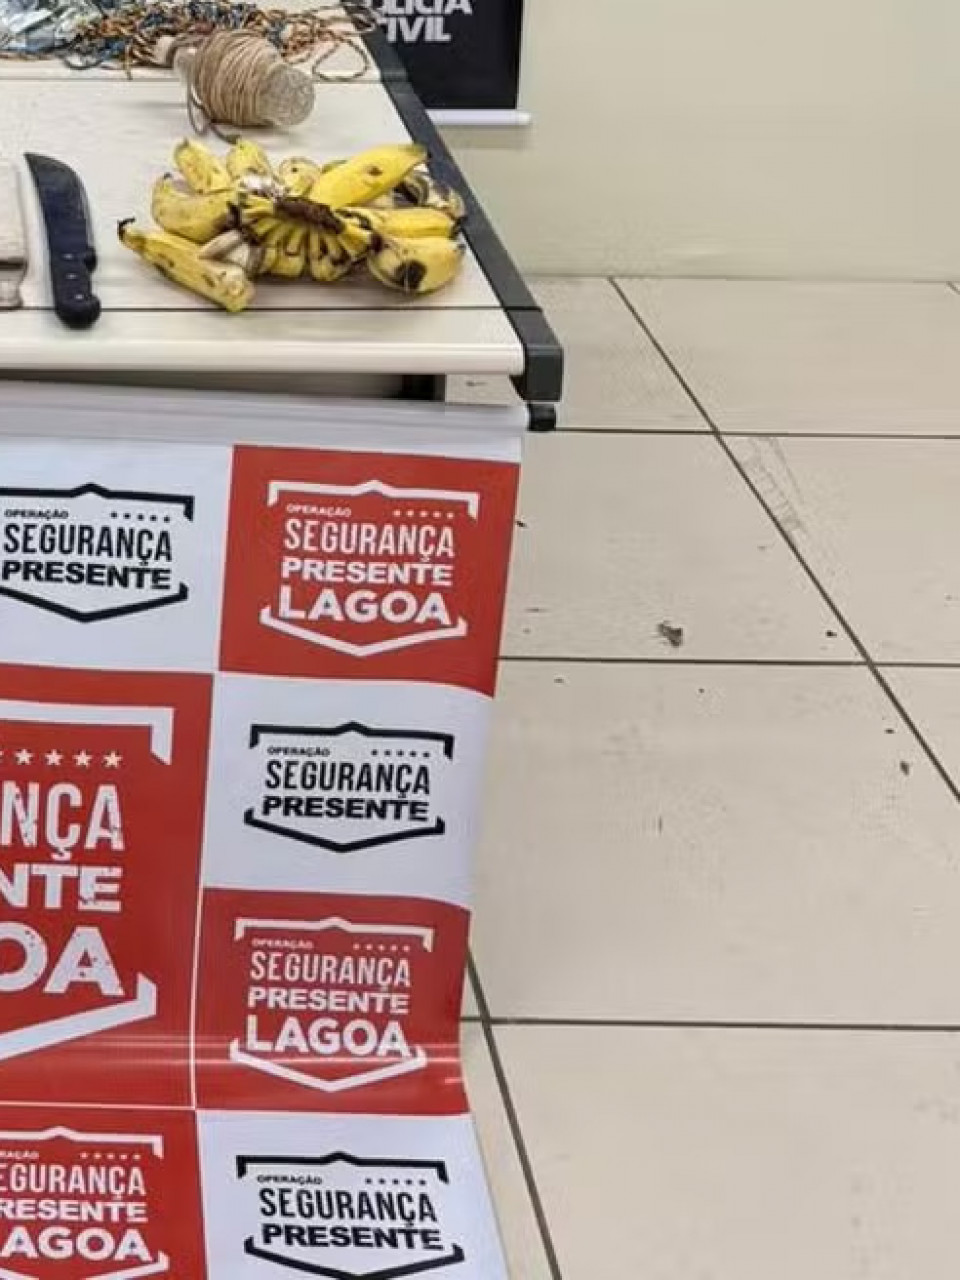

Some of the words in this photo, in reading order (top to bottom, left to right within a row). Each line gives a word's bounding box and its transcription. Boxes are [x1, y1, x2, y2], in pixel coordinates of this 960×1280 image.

[376, 16, 451, 42] IVIL
[4, 523, 172, 565] SEGURANÇA
[284, 519, 455, 562] SEGURANÇA
[2, 561, 171, 590] PRESENTE
[282, 557, 453, 586] PRESENTE
[278, 584, 451, 625] LAGOA
[265, 760, 430, 800] SEGURANÇA
[262, 795, 429, 821] PRESENTE
[250, 951, 411, 991] SEGURANÇA
[248, 987, 409, 1014] PRESENTE
[246, 1014, 411, 1057] LAGOA
[259, 1188, 437, 1227] SEGURANÇA
[262, 1223, 443, 1251] PRESENTE
